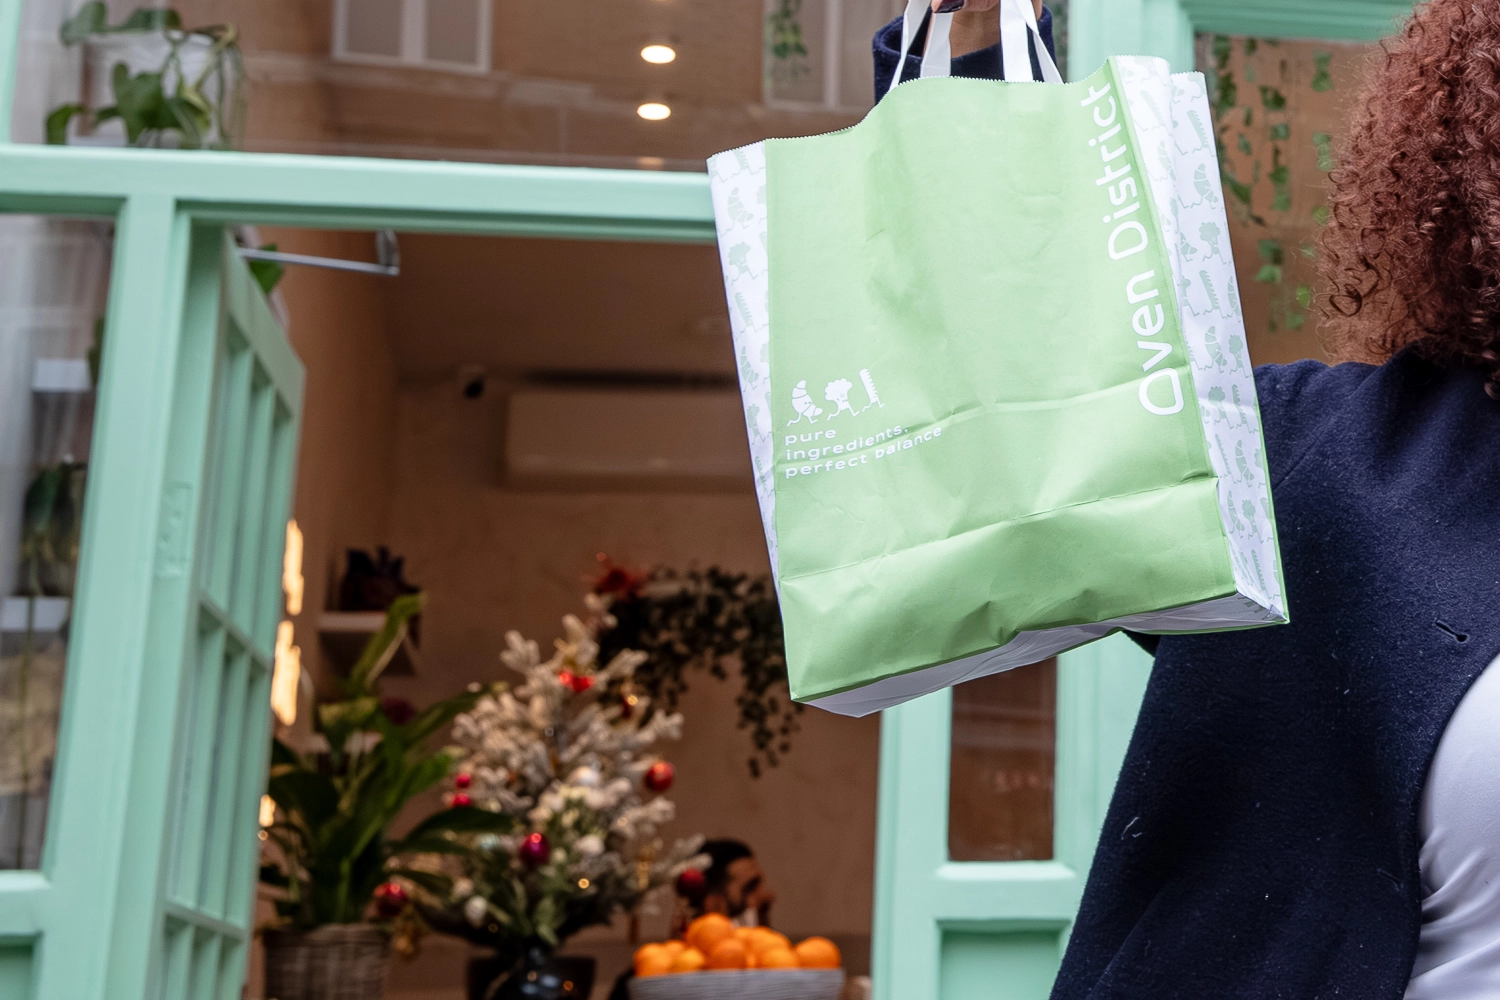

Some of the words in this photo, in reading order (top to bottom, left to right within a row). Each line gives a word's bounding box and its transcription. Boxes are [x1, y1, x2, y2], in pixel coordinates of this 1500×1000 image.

[1080, 82, 1149, 261] District
[1126, 269, 1185, 416] Oven
[784, 429, 837, 447] pure
[785, 425, 910, 461] ingredients,
[785, 453, 868, 479] perfect
[874, 427, 943, 460] balance
